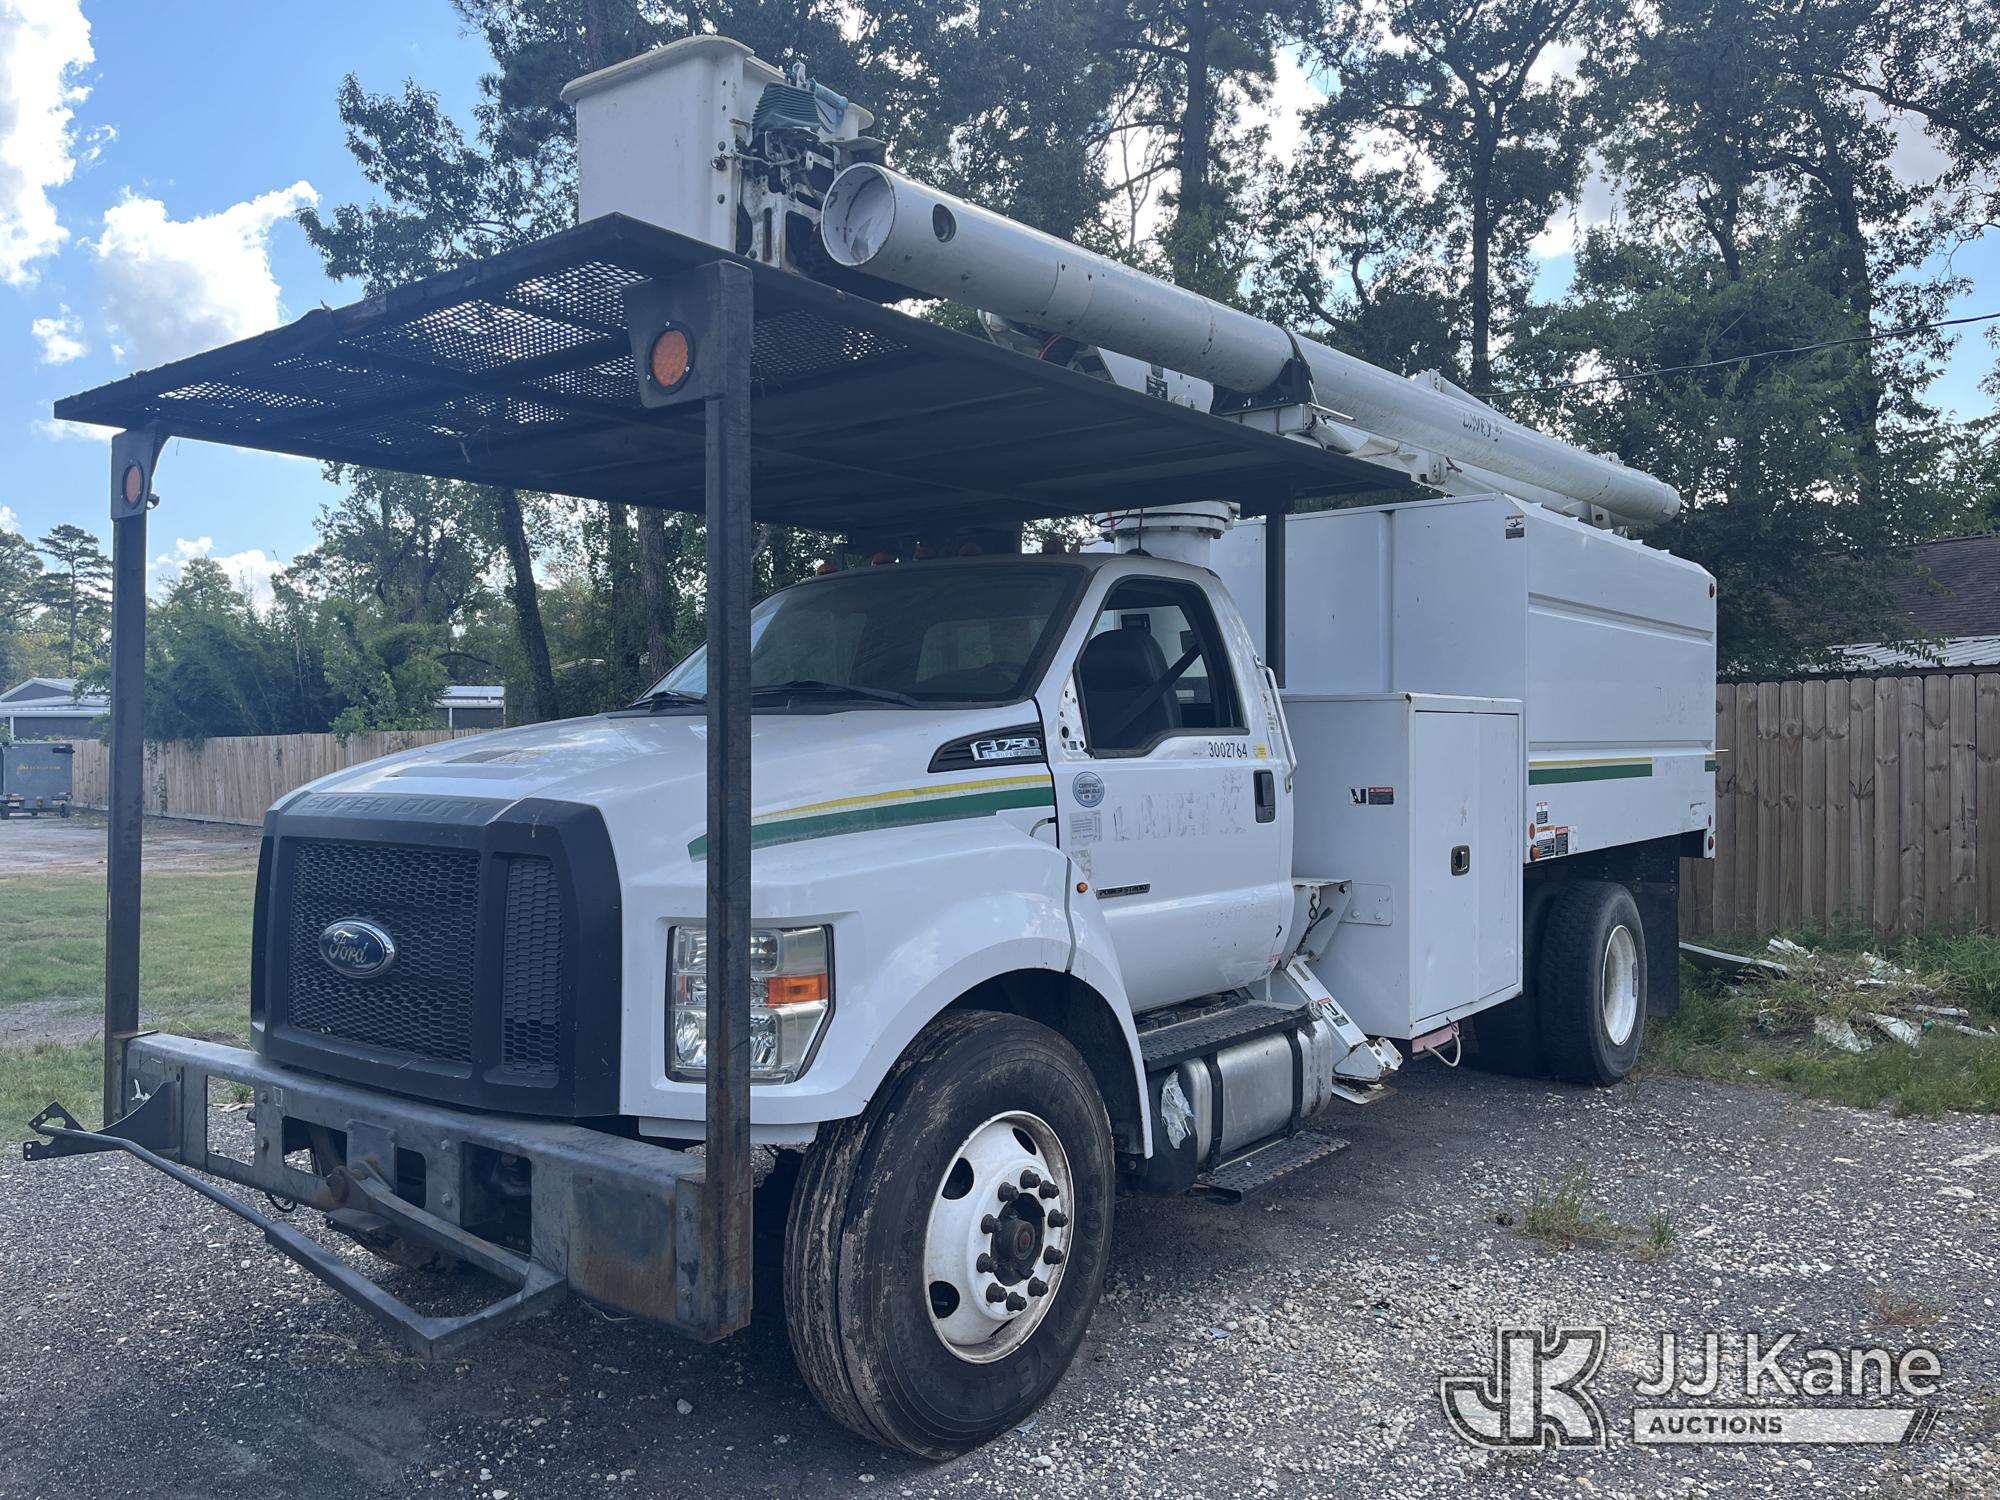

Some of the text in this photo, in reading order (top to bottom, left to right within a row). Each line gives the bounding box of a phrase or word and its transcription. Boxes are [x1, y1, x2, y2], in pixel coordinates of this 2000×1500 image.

[1208, 742, 1248, 758] 3002764
[302, 796, 490, 819] SUPER DUTY
[328, 930, 369, 964] Ford
